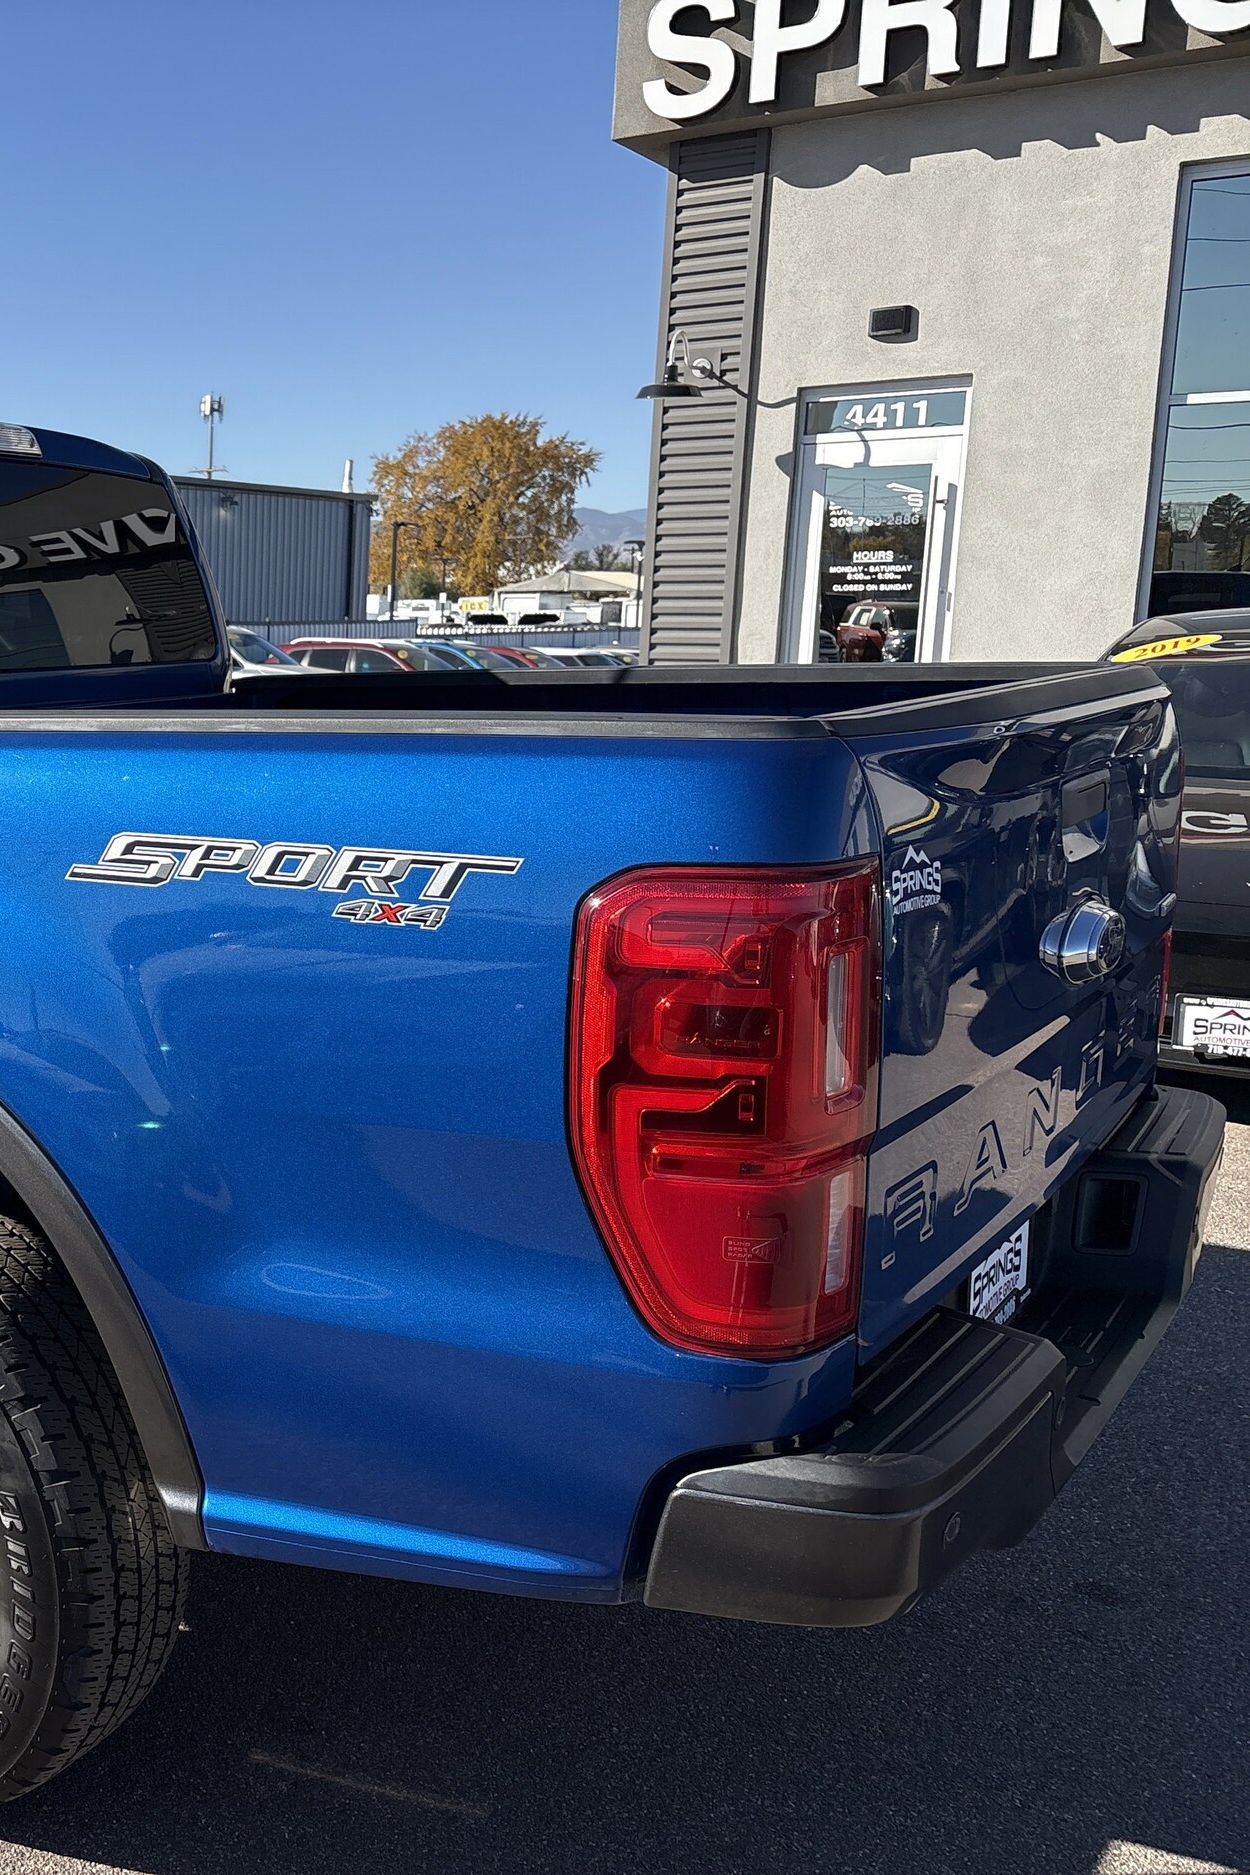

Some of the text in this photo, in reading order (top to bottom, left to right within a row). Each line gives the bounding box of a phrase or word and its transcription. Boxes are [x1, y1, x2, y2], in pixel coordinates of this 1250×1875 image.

[642, 0, 1250, 119] SPRIN
[844, 400, 928, 429] 4411
[852, 550, 894, 563] HOURS
[869, 564, 913, 573] SATURDAY
[832, 584, 865, 592] CLOSED
[879, 583, 913, 591] SUNDAY
[1134, 636, 1202, 659] 2019
[64, 831, 526, 901] SPORT
[892, 860, 942, 906] SPRINGS
[893, 894, 941, 916] AUTOMOTIVE GROUP
[972, 1232, 1022, 1316] SPRINGS
[979, 1285, 1003, 1319] TOMOTIVE
